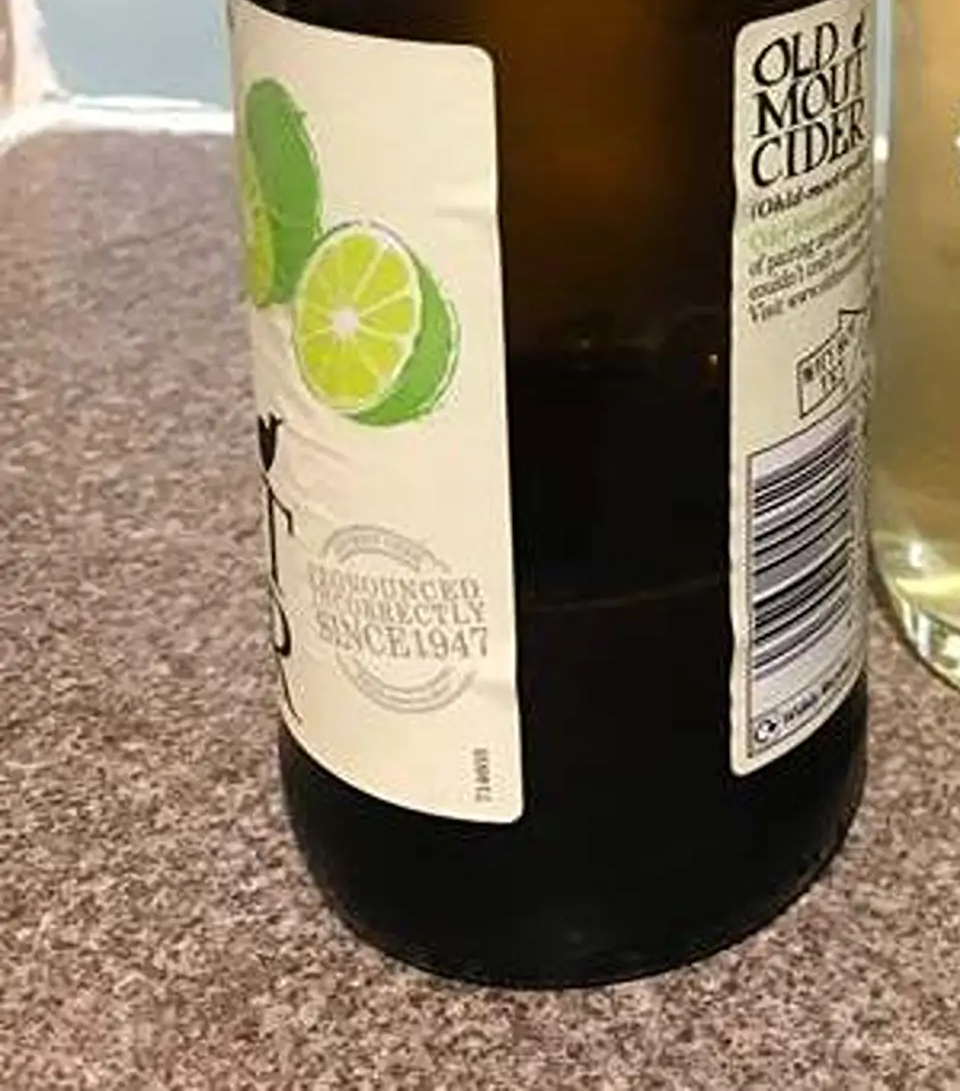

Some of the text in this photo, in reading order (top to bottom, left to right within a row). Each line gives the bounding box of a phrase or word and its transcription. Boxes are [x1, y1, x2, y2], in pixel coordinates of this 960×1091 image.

[751, 46, 867, 138] MOUT
[753, 22, 839, 87] OLD
[751, 98, 866, 188] CIDER
